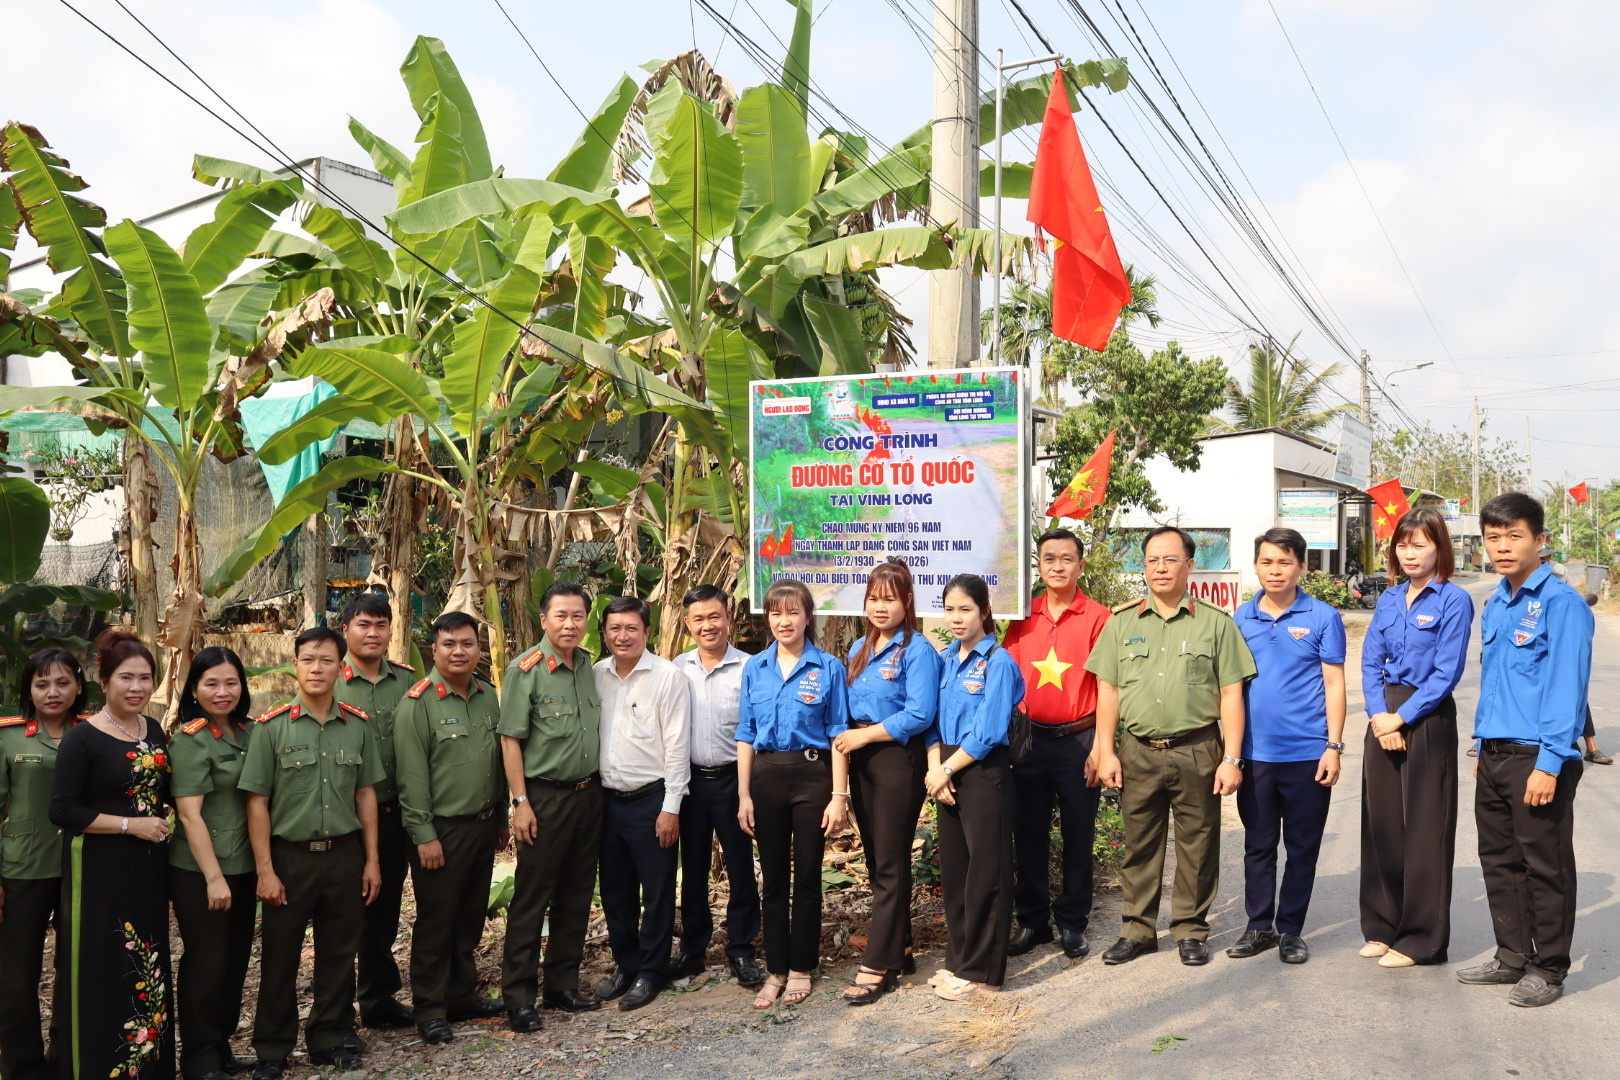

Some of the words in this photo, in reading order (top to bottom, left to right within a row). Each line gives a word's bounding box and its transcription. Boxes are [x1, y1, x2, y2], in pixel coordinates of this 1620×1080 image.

[824, 434, 874, 451] CÔNG
[880, 432, 938, 449] TRÌNH
[791, 461, 853, 488] ĐƯỜNG
[859, 459, 885, 486] CỜ
[890, 455, 915, 485] TỔ
[921, 456, 975, 487] QUỐC
[830, 494, 853, 509] TẠI
[858, 491, 891, 506] VĨNH
[895, 492, 933, 506] LONG
[908, 521, 919, 533] 96
[952, 540, 972, 552] NAM
[834, 555, 874, 567] (3/2/1930
[1186, 581, 1239, 612] OCOPY
